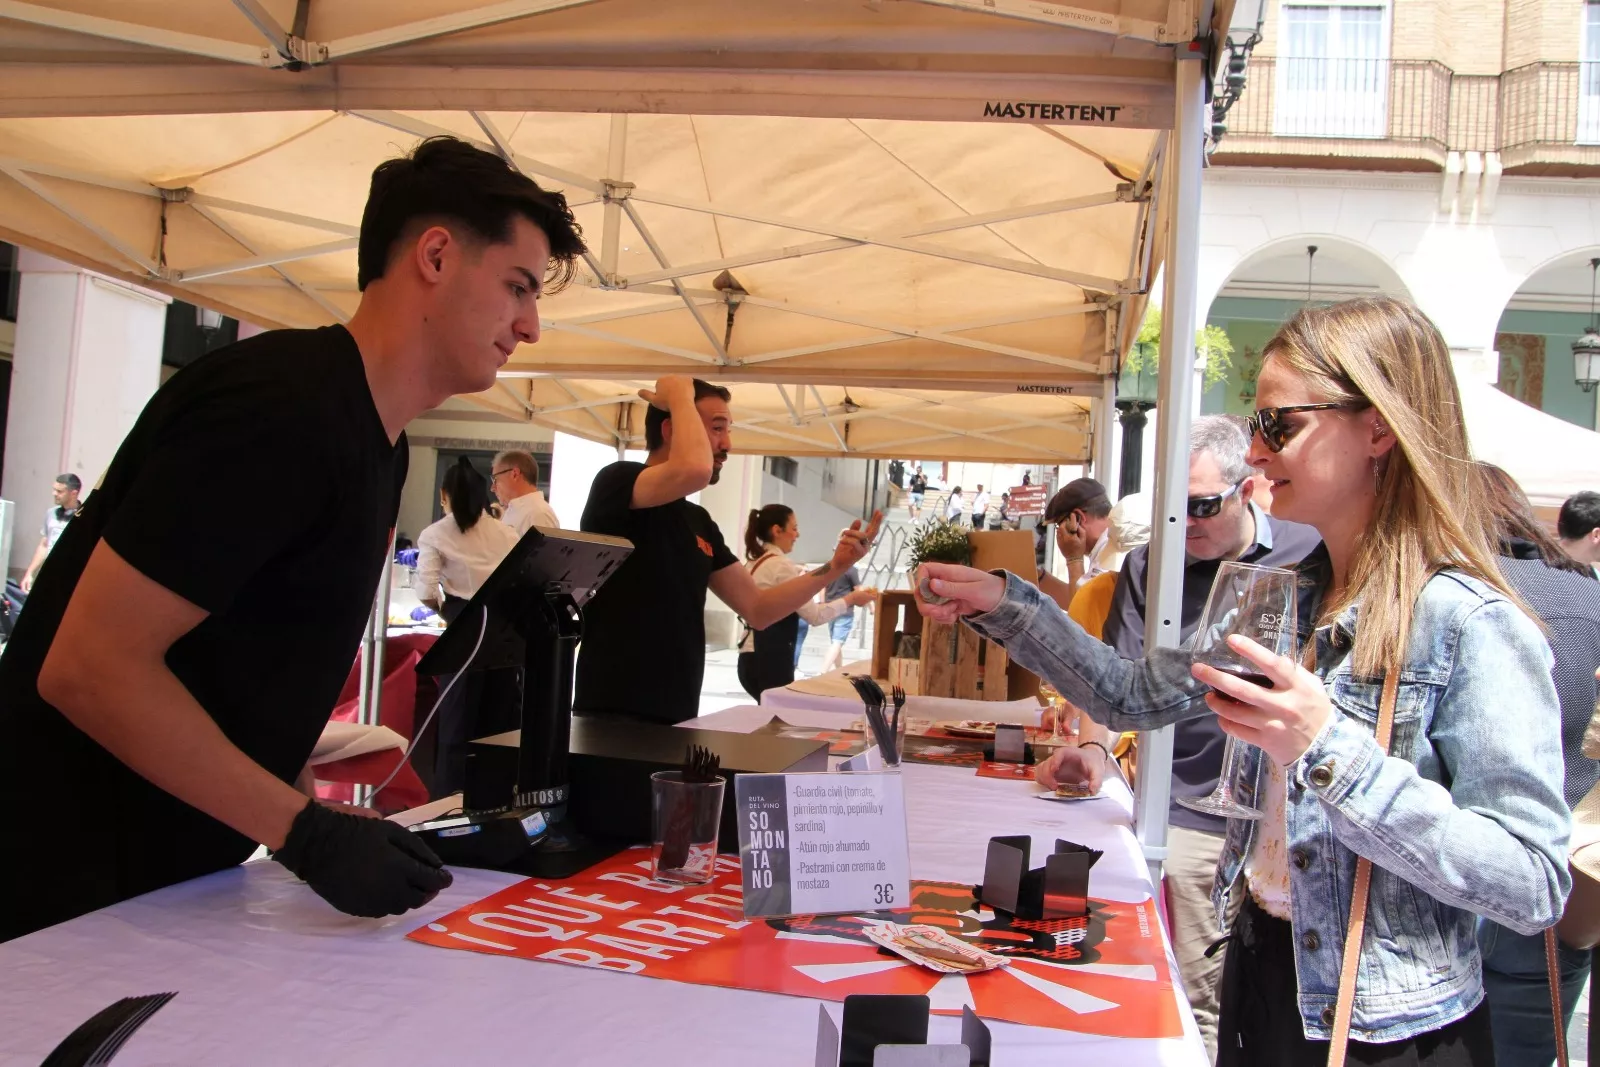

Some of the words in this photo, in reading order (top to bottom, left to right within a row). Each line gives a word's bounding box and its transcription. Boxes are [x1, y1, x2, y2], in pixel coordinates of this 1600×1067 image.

[983, 102, 1121, 122] MASTERTENT
[1016, 385, 1073, 394] MASTERTENT
[793, 785, 826, 798] -Guardia
[827, 785, 842, 798] civil
[844, 785, 875, 799] (tomate,
[793, 804, 828, 817] pimiento
[829, 804, 846, 817] rojo,
[847, 803, 878, 817] pepinillo
[878, 804, 883, 815] y
[749, 811, 769, 830] SO
[794, 820, 826, 834] sardina)
[750, 830, 785, 850] MON
[819, 841, 834, 853] rojo
[835, 840, 870, 852] ahumado
[750, 850, 771, 869] TA
[796, 861, 835, 874] -Pastrami
[836, 863, 850, 873] con
[851, 862, 875, 873] crema
[876, 860, 886, 871] de
[752, 869, 773, 889] NO
[797, 878, 830, 890] mostaza
[873, 883, 894, 905] 3€
